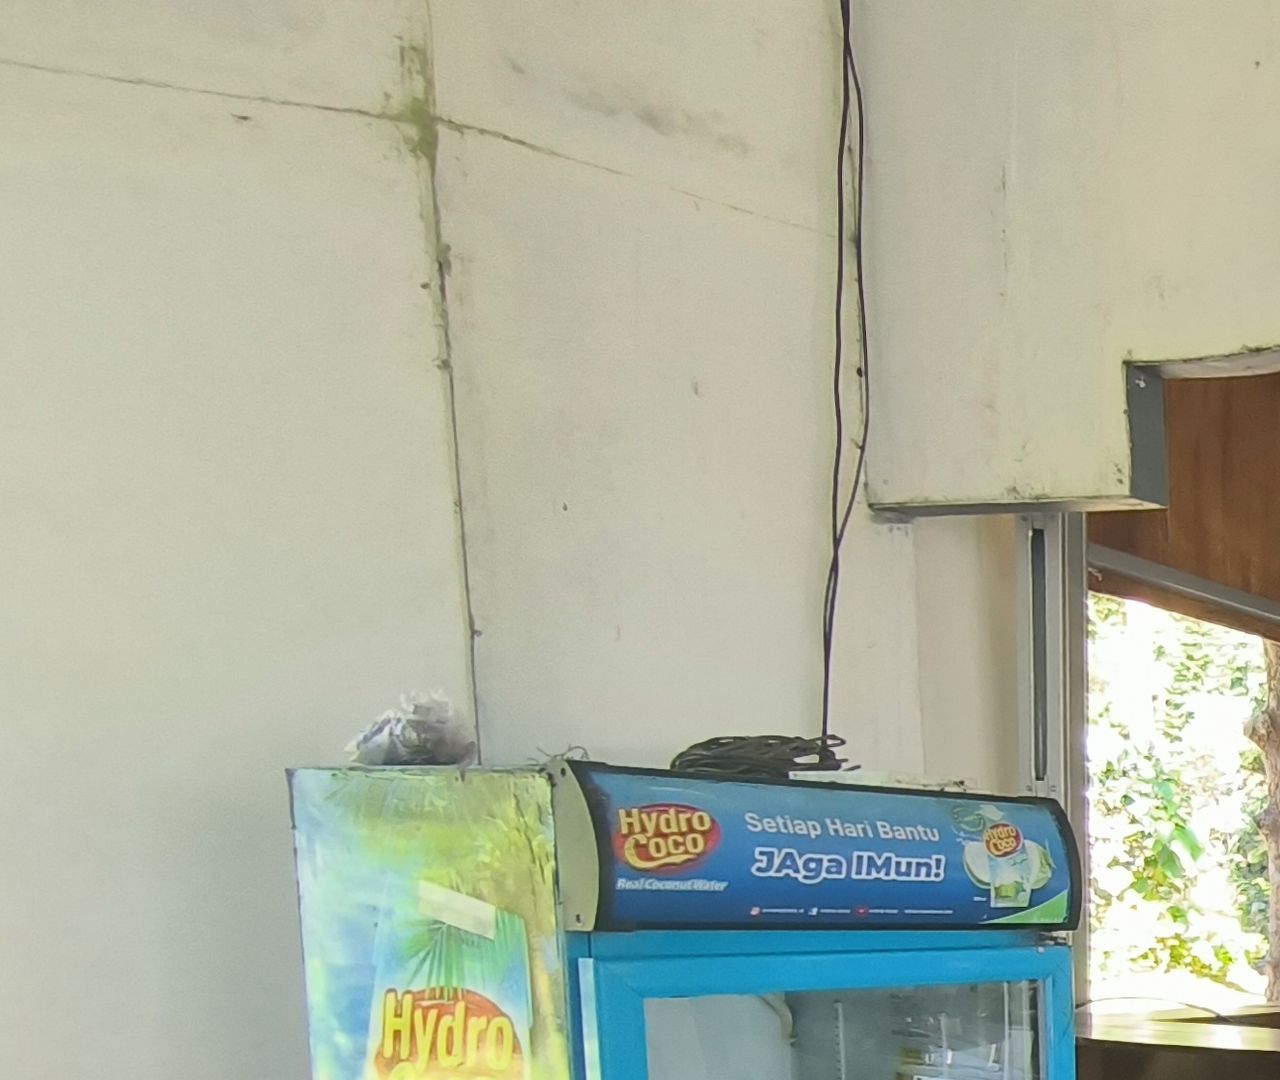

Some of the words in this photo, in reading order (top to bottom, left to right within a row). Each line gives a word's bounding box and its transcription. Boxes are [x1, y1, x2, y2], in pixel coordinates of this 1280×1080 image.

[618, 808, 712, 837] Hydro
[744, 812, 822, 839] Setiap
[825, 817, 874, 838] Hari
[876, 820, 940, 842] Bantu
[624, 834, 705, 869] Coco
[751, 846, 847, 884] JAga
[851, 851, 946, 882] IMun!
[616, 878, 643, 890] Real
[643, 878, 694, 891] Coconut
[692, 879, 728, 891] Water
[382, 989, 516, 1072] Hydro
